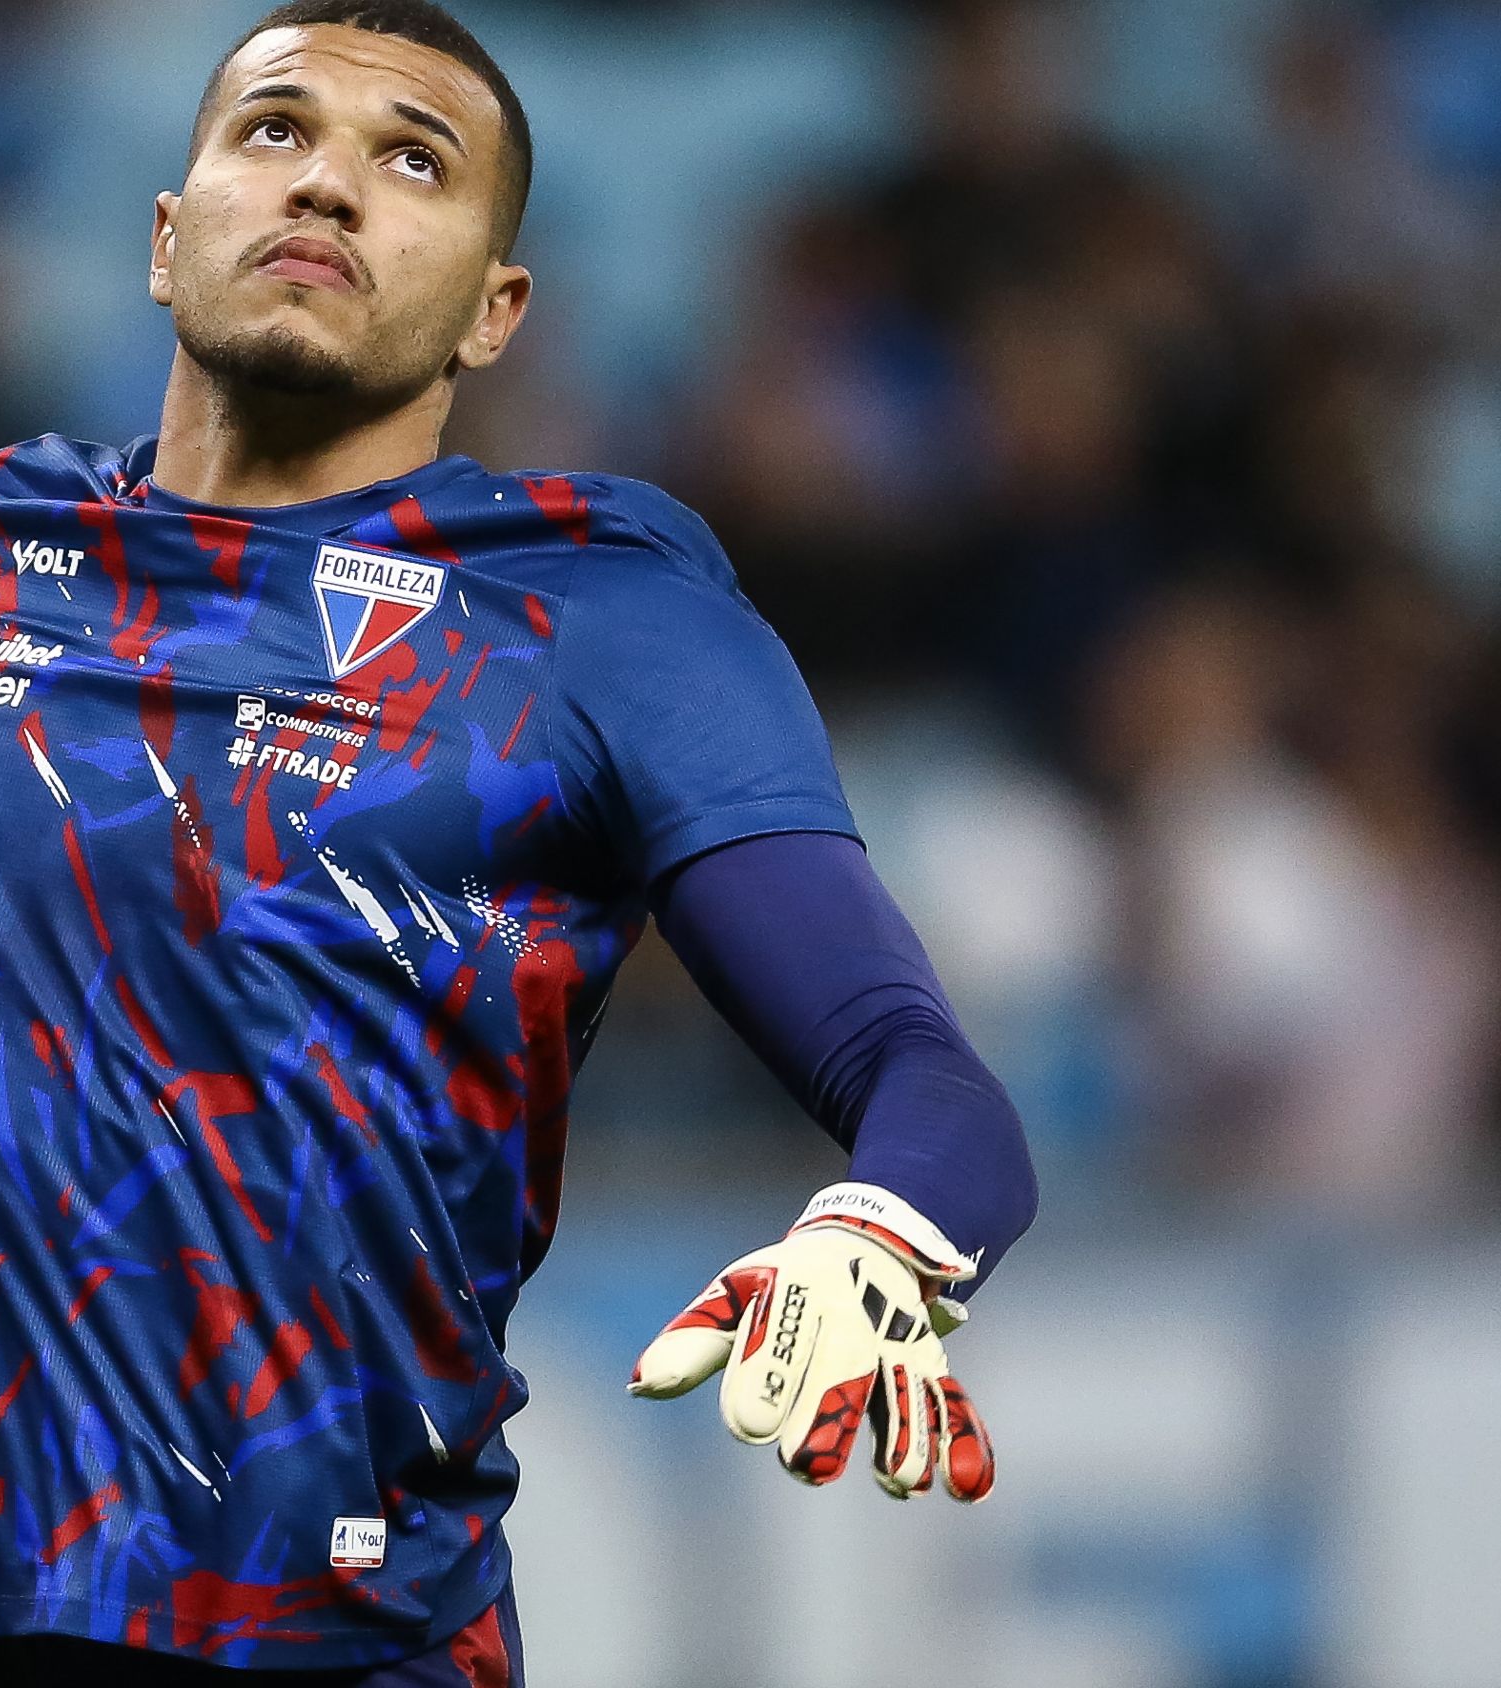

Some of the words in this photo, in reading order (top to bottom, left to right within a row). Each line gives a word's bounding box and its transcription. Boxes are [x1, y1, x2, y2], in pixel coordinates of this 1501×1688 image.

[12, 540, 85, 577] VOLT
[319, 553, 437, 596] FORTALEZA
[265, 712, 368, 748] COMBUSTIVEIS
[357, 1531, 384, 1548] VOLT
